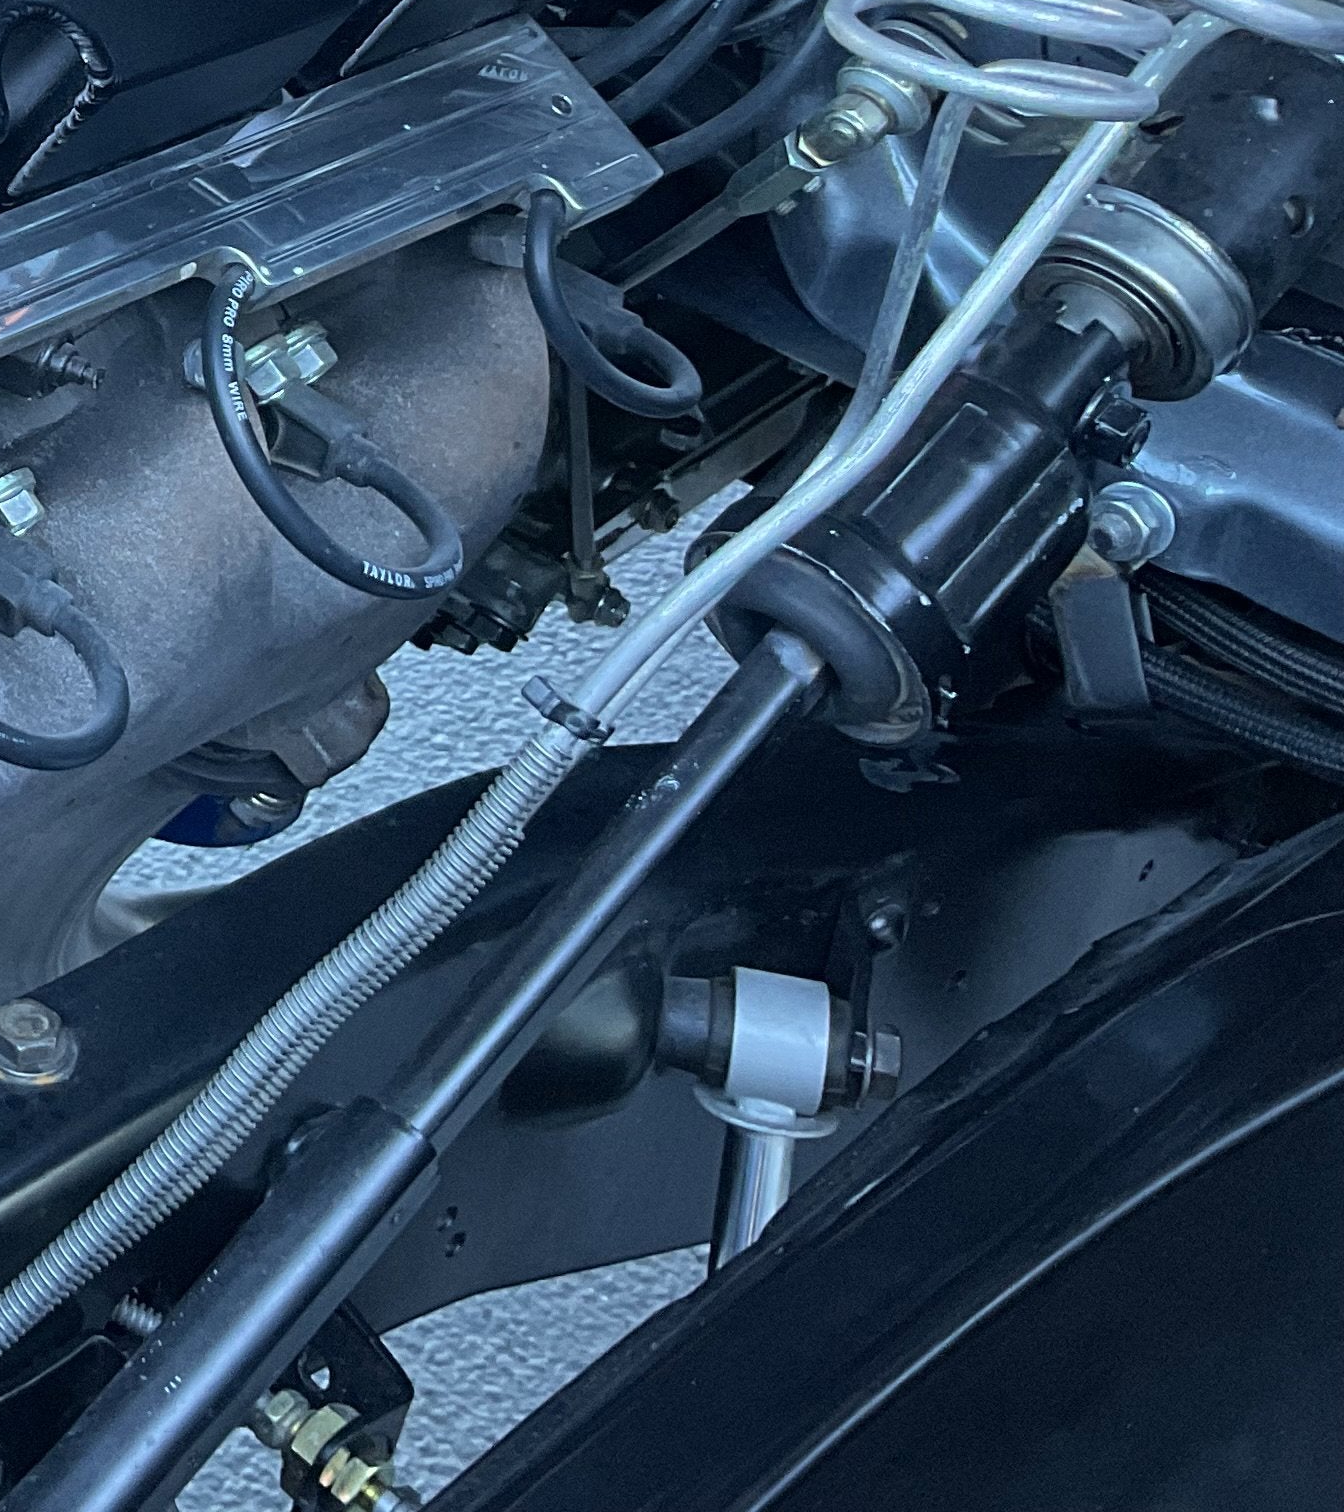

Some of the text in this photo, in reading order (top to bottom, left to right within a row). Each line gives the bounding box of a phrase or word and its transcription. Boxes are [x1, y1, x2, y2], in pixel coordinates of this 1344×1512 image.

[223, 297, 240, 329] PRO
[221, 333, 235, 373] 8mm
[227, 381, 249, 423] WIRE
